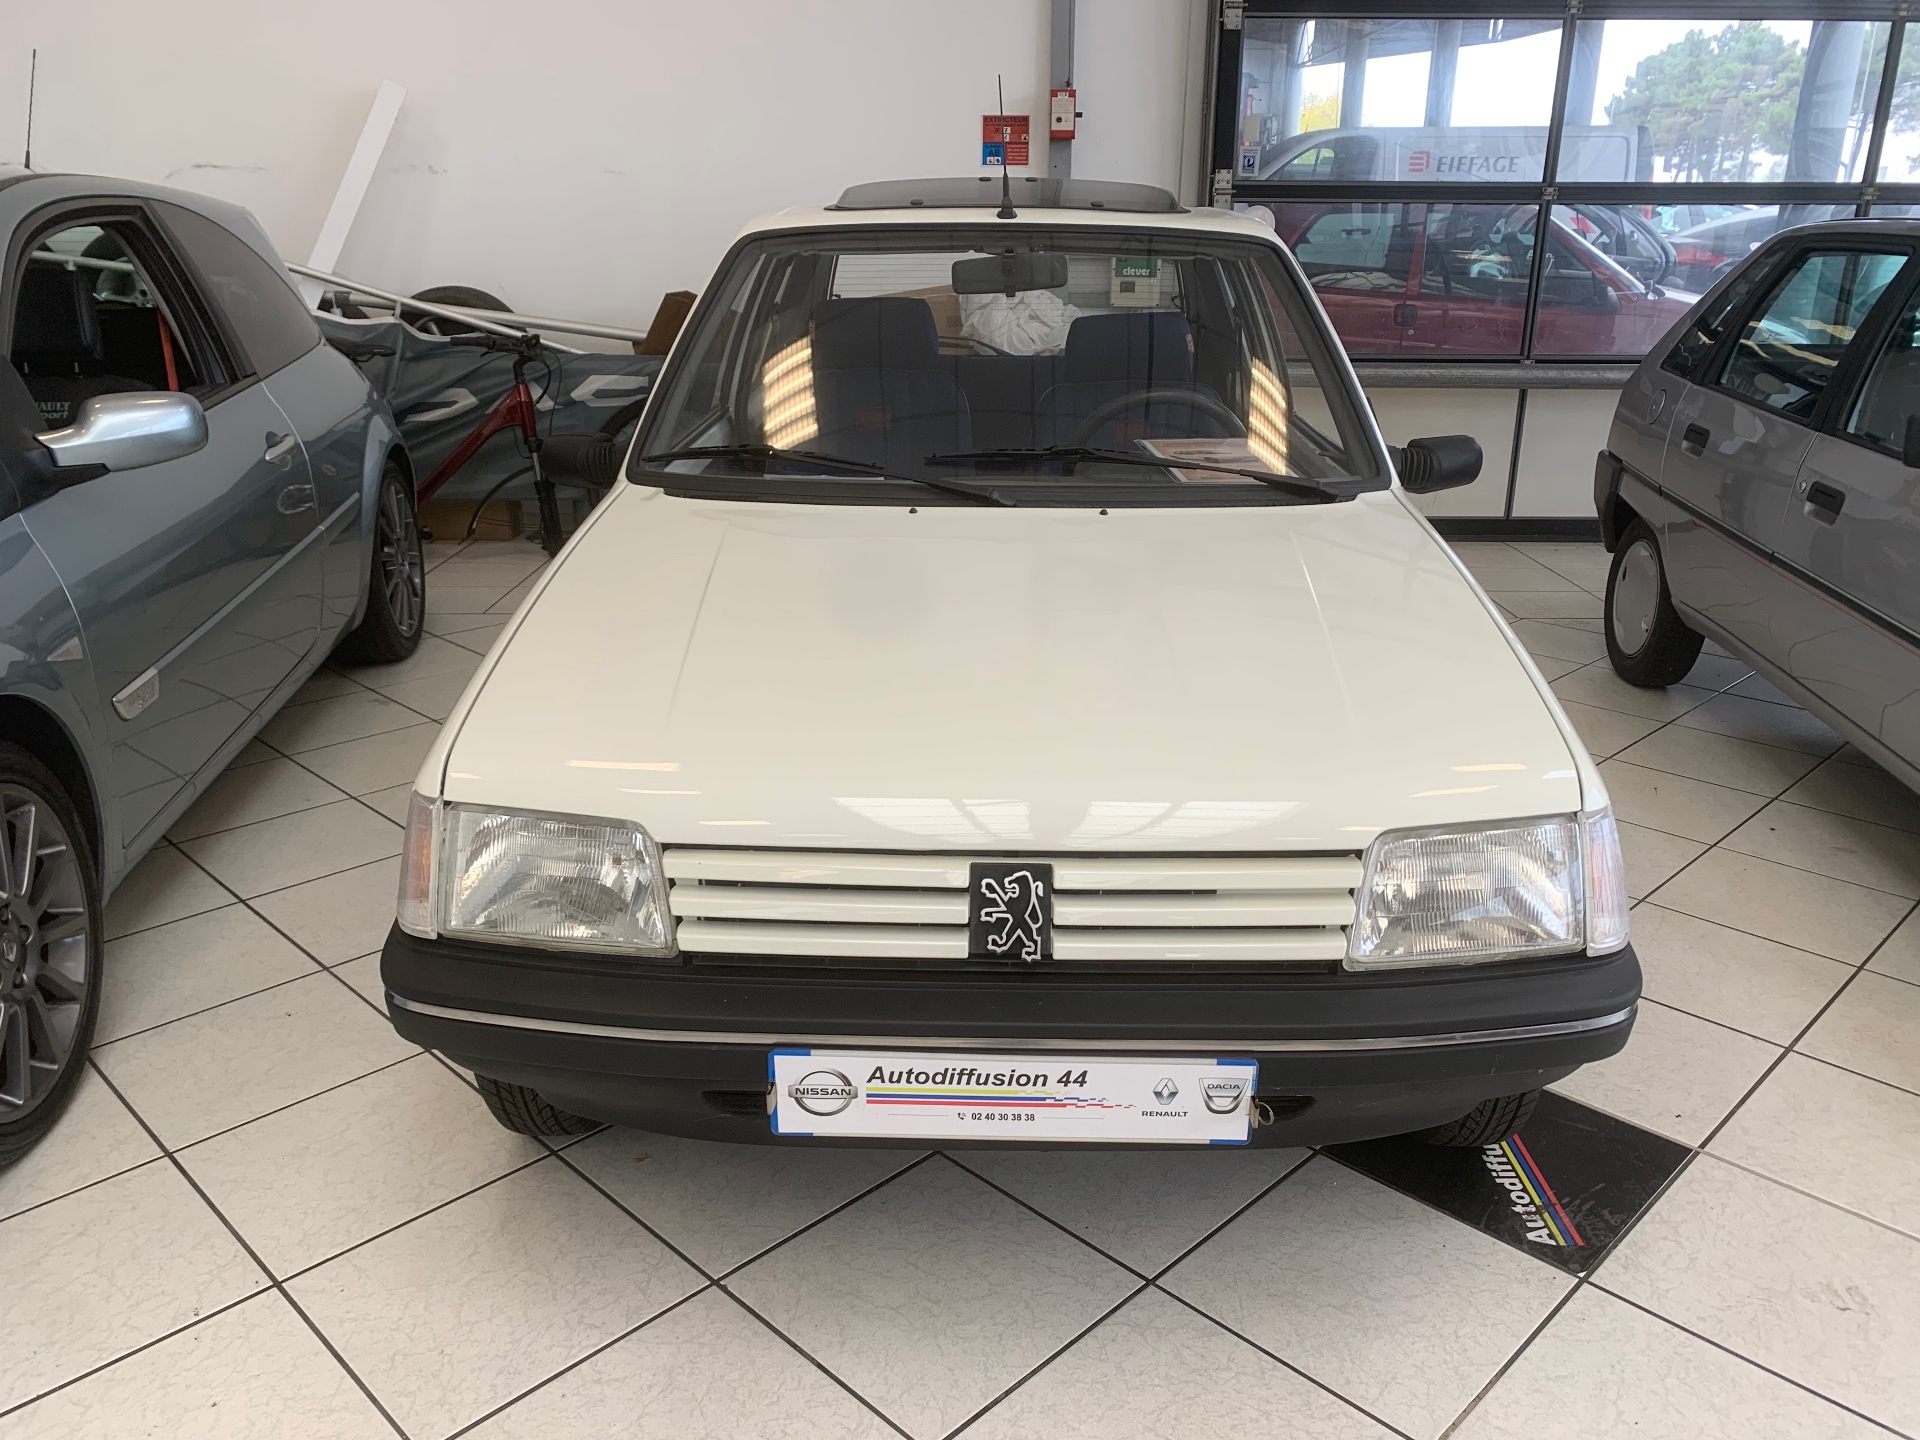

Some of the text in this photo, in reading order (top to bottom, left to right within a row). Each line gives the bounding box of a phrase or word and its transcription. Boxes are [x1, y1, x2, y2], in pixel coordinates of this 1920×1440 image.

[1436, 155, 1520, 173] EIFFAGE
[866, 1065, 1088, 1088] Autodiffusion 44
[795, 1087, 851, 1096] NISSAN
[971, 1112, 1035, 1122] 02 40 30 38 38
[1141, 1110, 1189, 1118] RENAULT
